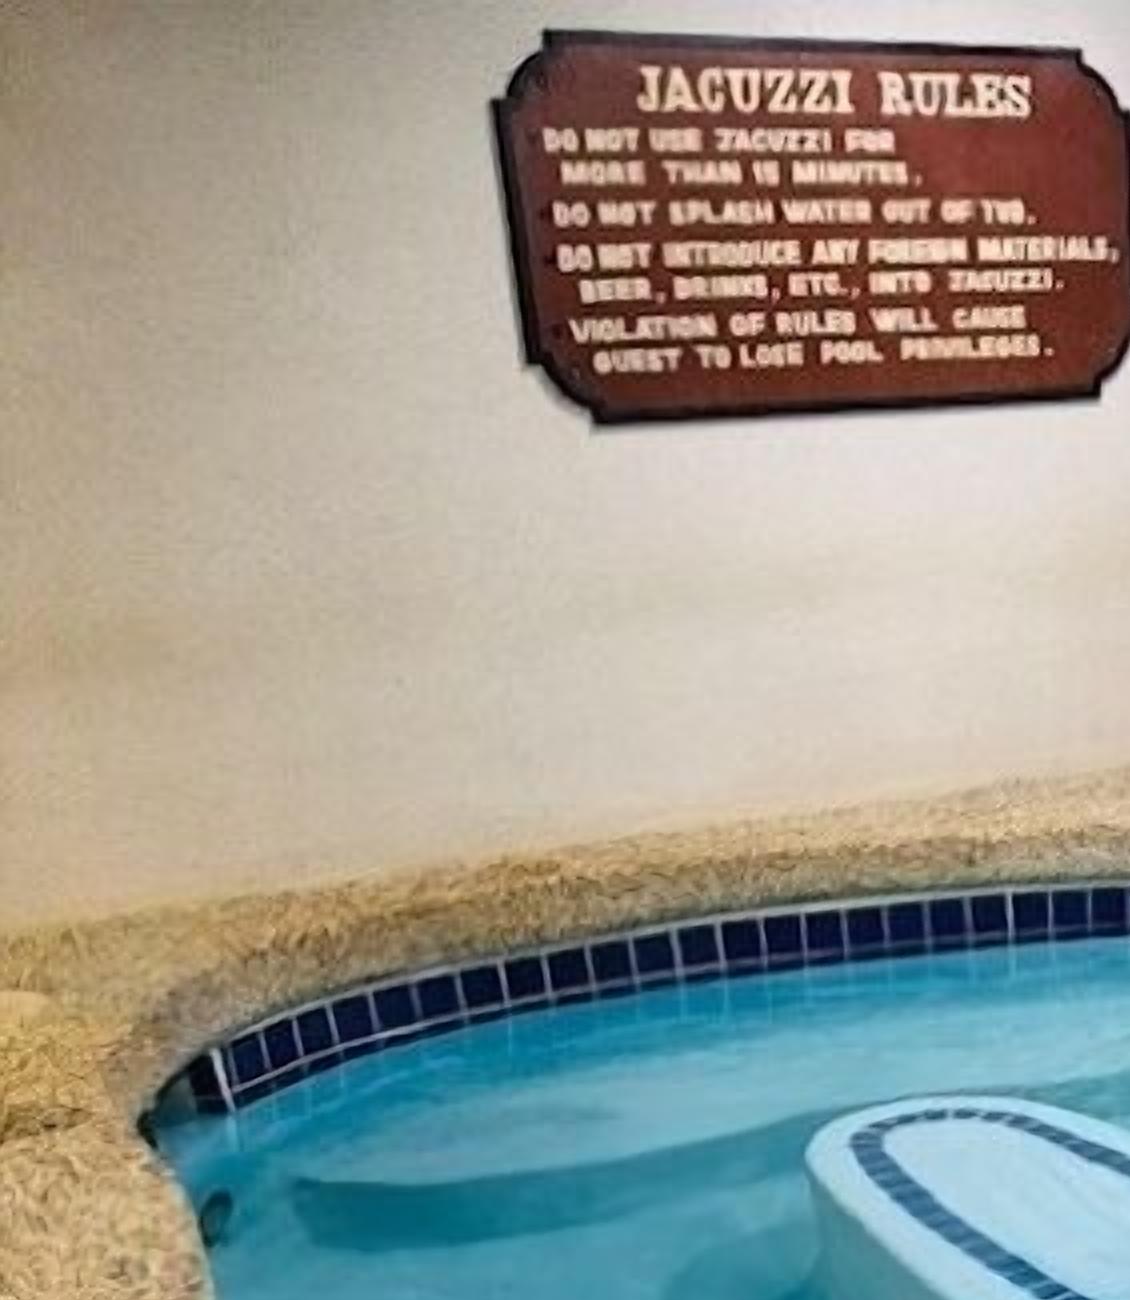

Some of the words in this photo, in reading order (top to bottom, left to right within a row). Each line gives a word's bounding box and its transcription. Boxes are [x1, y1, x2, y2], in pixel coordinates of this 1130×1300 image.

[636, 65, 856, 115] JACUZZI
[876, 70, 1032, 119] RULES
[542, 127, 579, 153] DO
[584, 127, 640, 153] NOT
[648, 127, 703, 153] USE
[714, 127, 832, 153] JACUZZI
[844, 128, 895, 153] FOR
[560, 160, 645, 186] MORE
[662, 160, 743, 185] THAN
[552, 201, 591, 228] DO
[597, 200, 656, 226] NOT
[668, 199, 775, 226] SPLASH
[781, 198, 872, 224] WATER
[881, 198, 932, 224] OUT
[940, 198, 976, 224] OF
[557, 243, 593, 273] DO
[597, 242, 652, 269] NOT
[662, 239, 802, 268] INTRODUCE
[811, 238, 860, 265] ANY
[867, 237, 968, 264] FOREIGN
[868, 269, 932, 295] INTO
[568, 312, 718, 344] VIOLATION
[729, 312, 766, 337] OF
[774, 309, 857, 337] RULES
[868, 307, 939, 333] WILL
[951, 304, 1027, 330] CAUSE
[592, 346, 683, 375] GUEST
[693, 344, 732, 369] TO
[739, 342, 804, 368] LOSE
[820, 339, 885, 365] POOL
